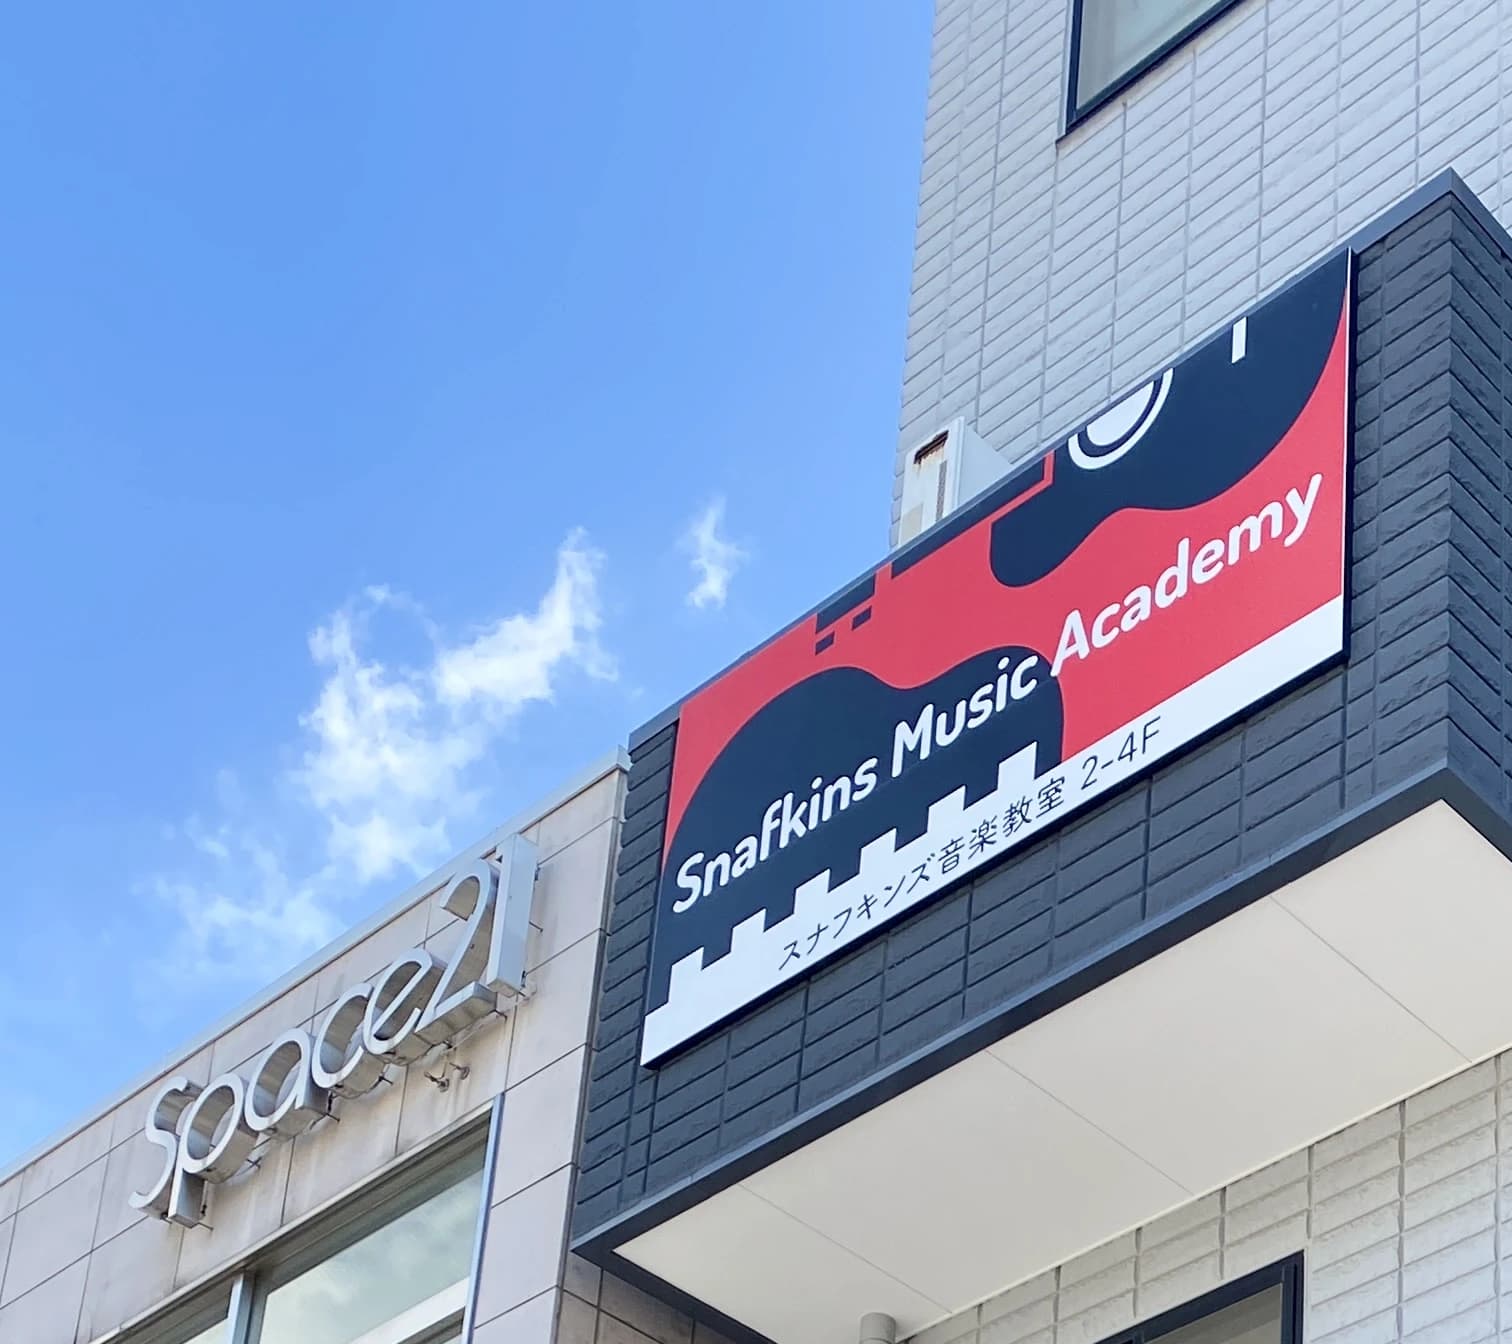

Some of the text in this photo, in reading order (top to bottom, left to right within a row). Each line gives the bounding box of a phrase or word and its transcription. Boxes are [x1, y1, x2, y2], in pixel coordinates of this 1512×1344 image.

[671, 472, 1324, 915] Snafkins Music Academy
[777, 714, 1165, 973] スナフキンズ音楽教室 2-4F
